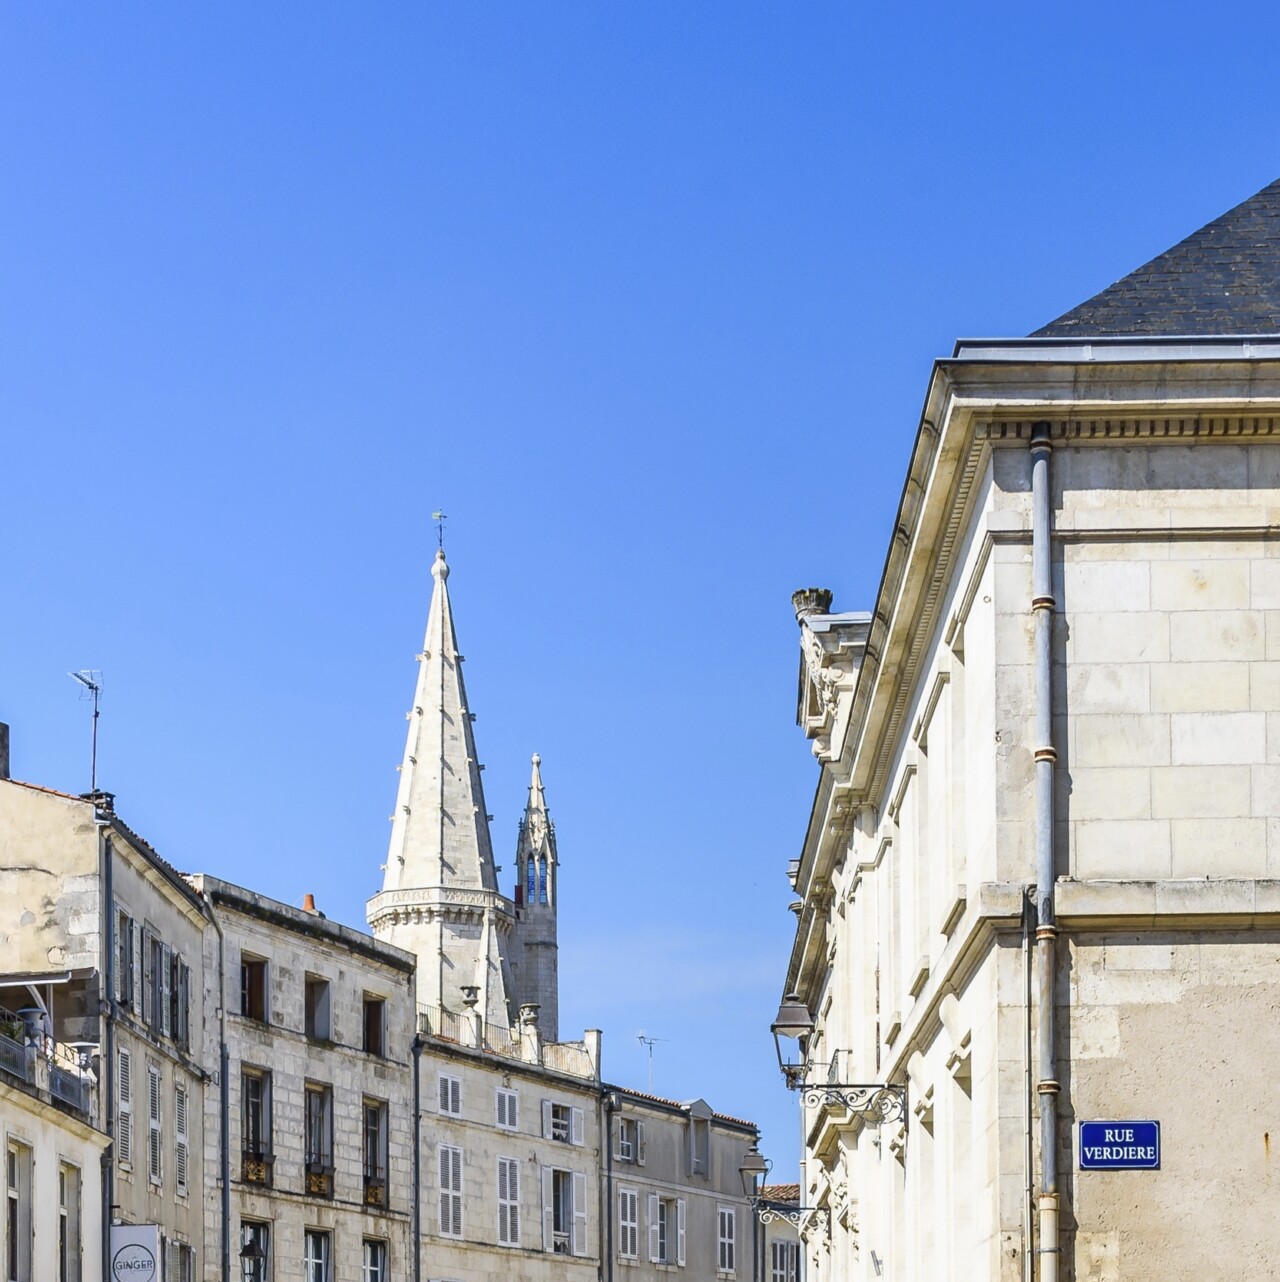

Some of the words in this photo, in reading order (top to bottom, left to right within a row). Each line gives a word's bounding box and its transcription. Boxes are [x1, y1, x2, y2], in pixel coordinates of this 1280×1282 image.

[1104, 1129, 1134, 1142] RUE
[1084, 1146, 1155, 1160] VERDIERE
[115, 1260, 153, 1271] GINGER
